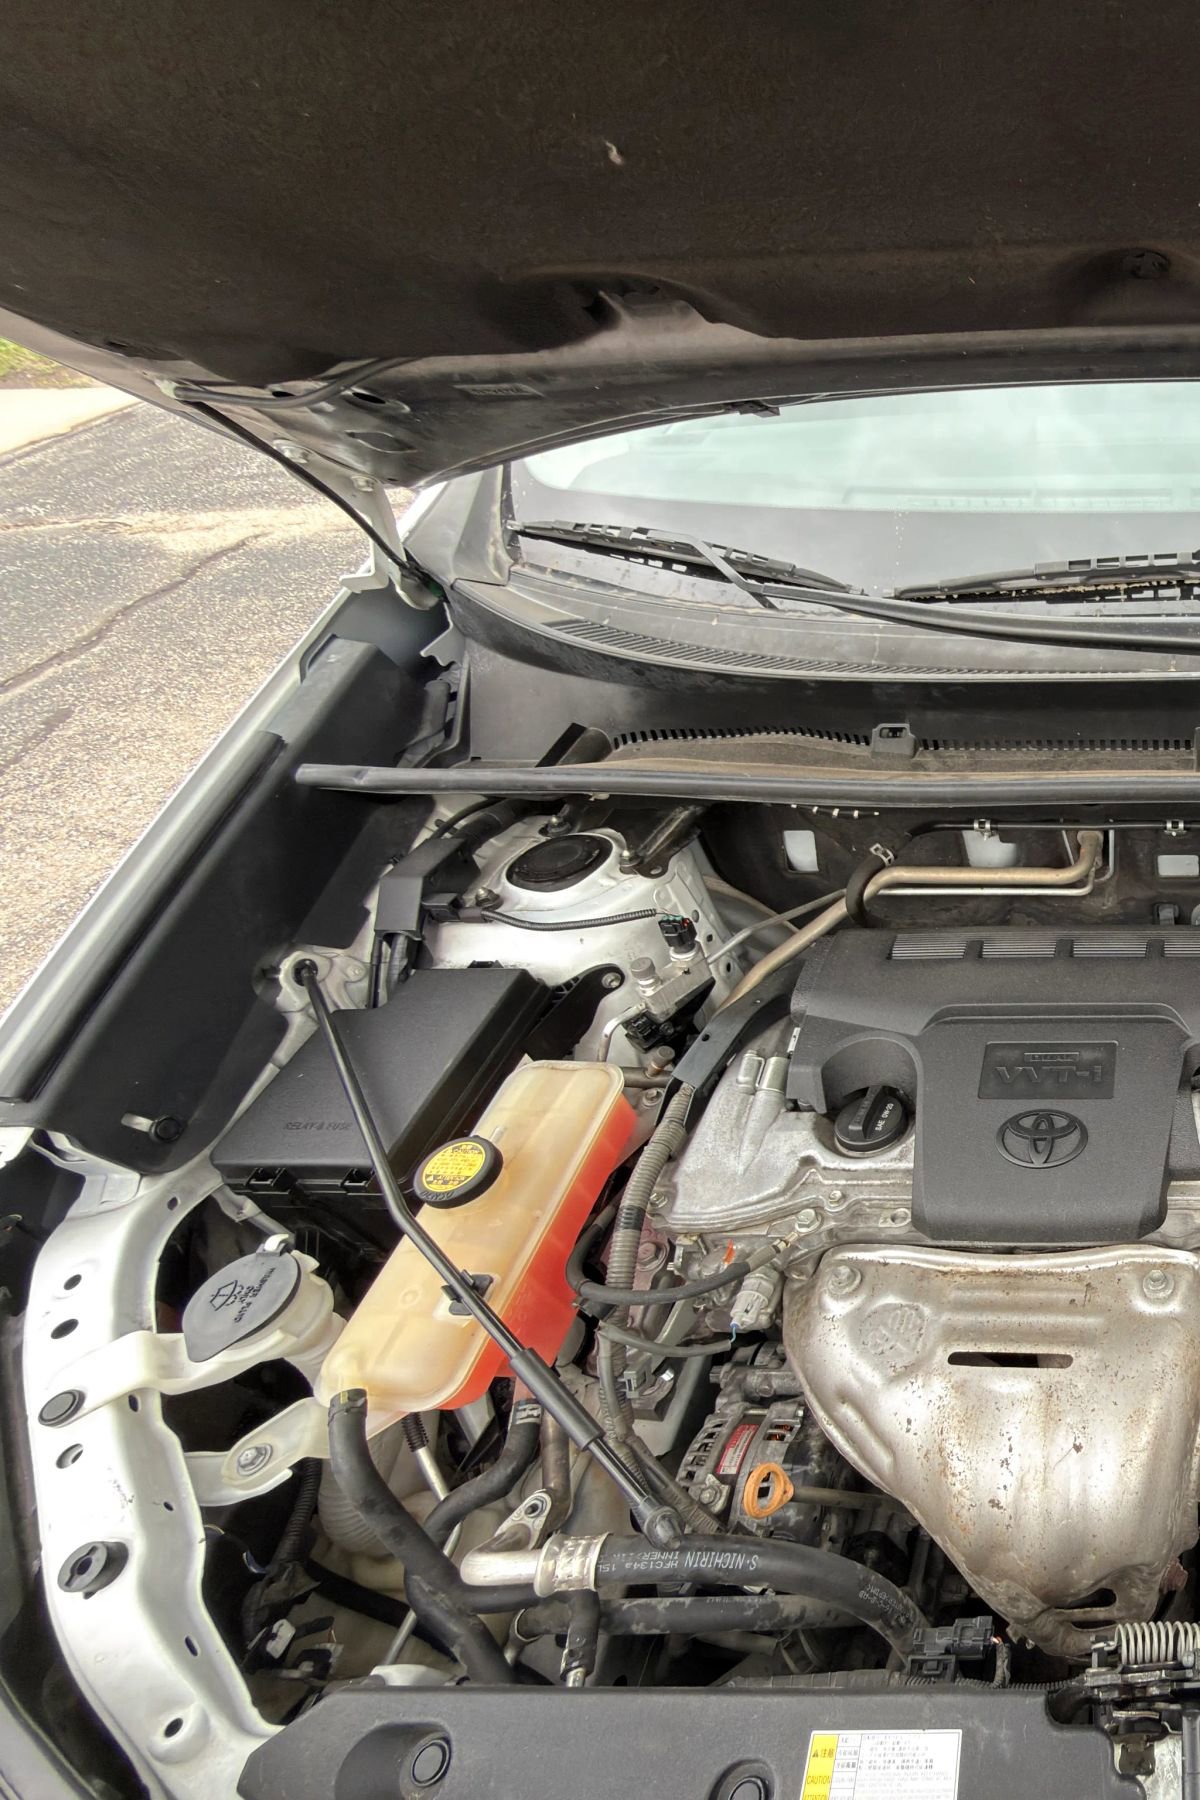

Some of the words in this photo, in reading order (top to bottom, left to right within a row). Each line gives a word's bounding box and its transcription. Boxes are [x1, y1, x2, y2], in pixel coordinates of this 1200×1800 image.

[874, 1119, 886, 1132] SAE
[881, 1103, 895, 1119] 0W-20
[625, 1560, 679, 1570] HFC134a
